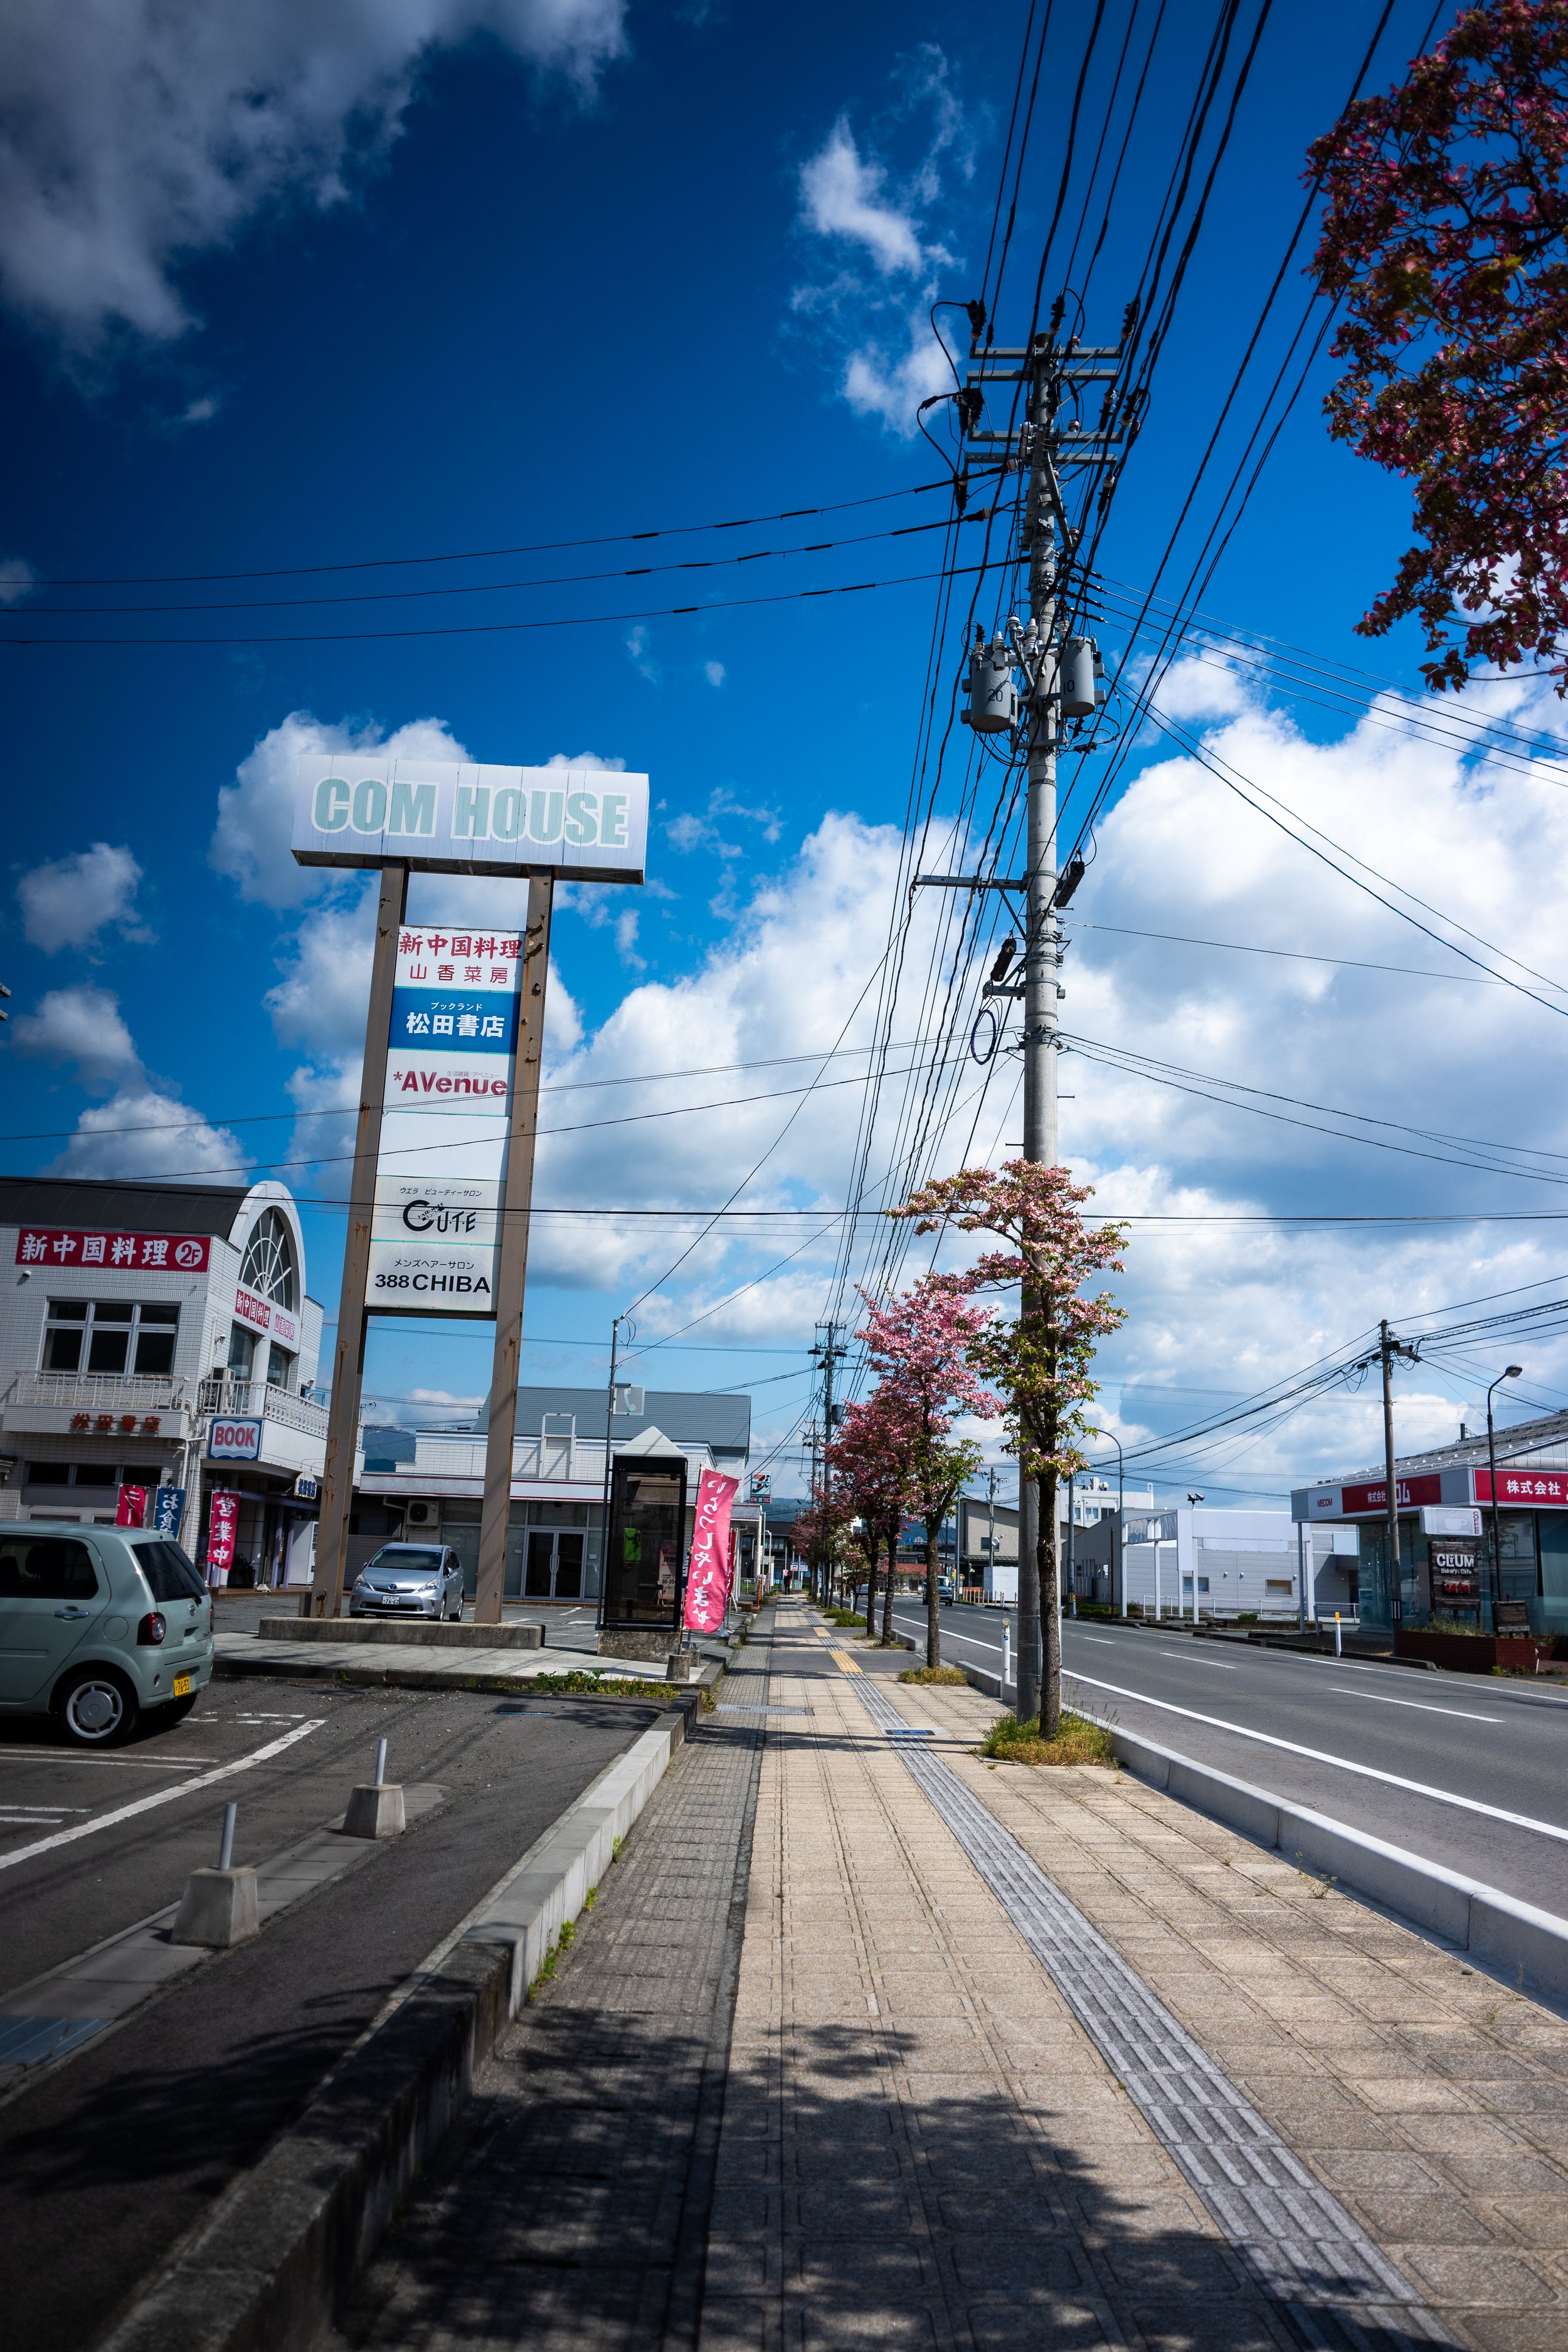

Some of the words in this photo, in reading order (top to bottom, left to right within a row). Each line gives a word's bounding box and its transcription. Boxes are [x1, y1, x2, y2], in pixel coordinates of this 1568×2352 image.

[1063, 679, 1075, 694] 10
[988, 689, 1003, 702] 20
[312, 776, 440, 837] COM
[450, 784, 631, 848] HOUSE
[399, 932, 522, 960] 新中国料理
[410, 963, 508, 984] 山香菜房
[430, 1002, 483, 1011] ブックランド
[406, 1011, 505, 1038] 松田書店
[21, 1233, 169, 1266] 新中国料理
[180, 1244, 201, 1264] 2F
[395, 1259, 474, 1269] メンズヘアーサロン
[236, 1292, 270, 1325] 新中国料理
[73, 1413, 161, 1431] 松田書店
[215, 1426, 256, 1447] BOOK
[1507, 1480, 1561, 1495] 株式会社
[1317, 1498, 1333, 1508] MECOM
[1367, 1490, 1386, 1504] 株式会社
[1444, 1581, 1470, 1592] cafe
